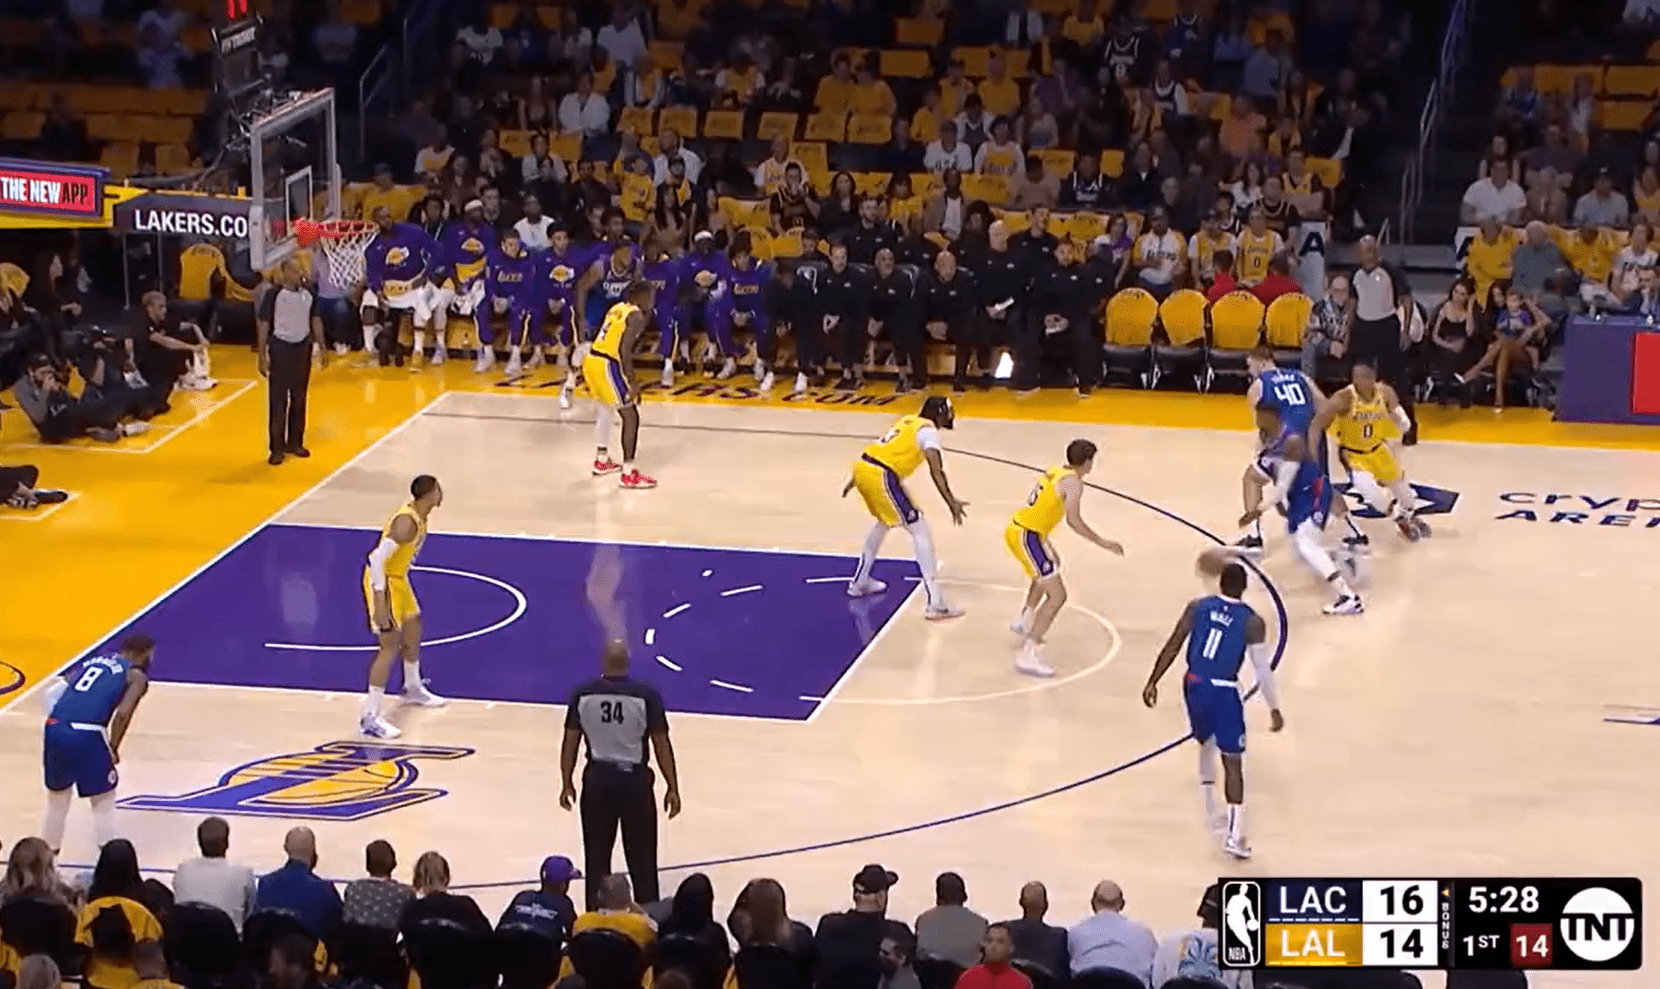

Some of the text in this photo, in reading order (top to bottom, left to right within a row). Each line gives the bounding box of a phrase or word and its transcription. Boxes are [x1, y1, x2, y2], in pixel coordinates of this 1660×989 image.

[1, 177, 88, 205] THE NEW APP
[135, 208, 248, 237] LAKERS.CO
[1274, 383, 1306, 406] 40
[1202, 627, 1223, 660] 11
[74, 666, 104, 692] 8
[600, 701, 624, 725] 34
